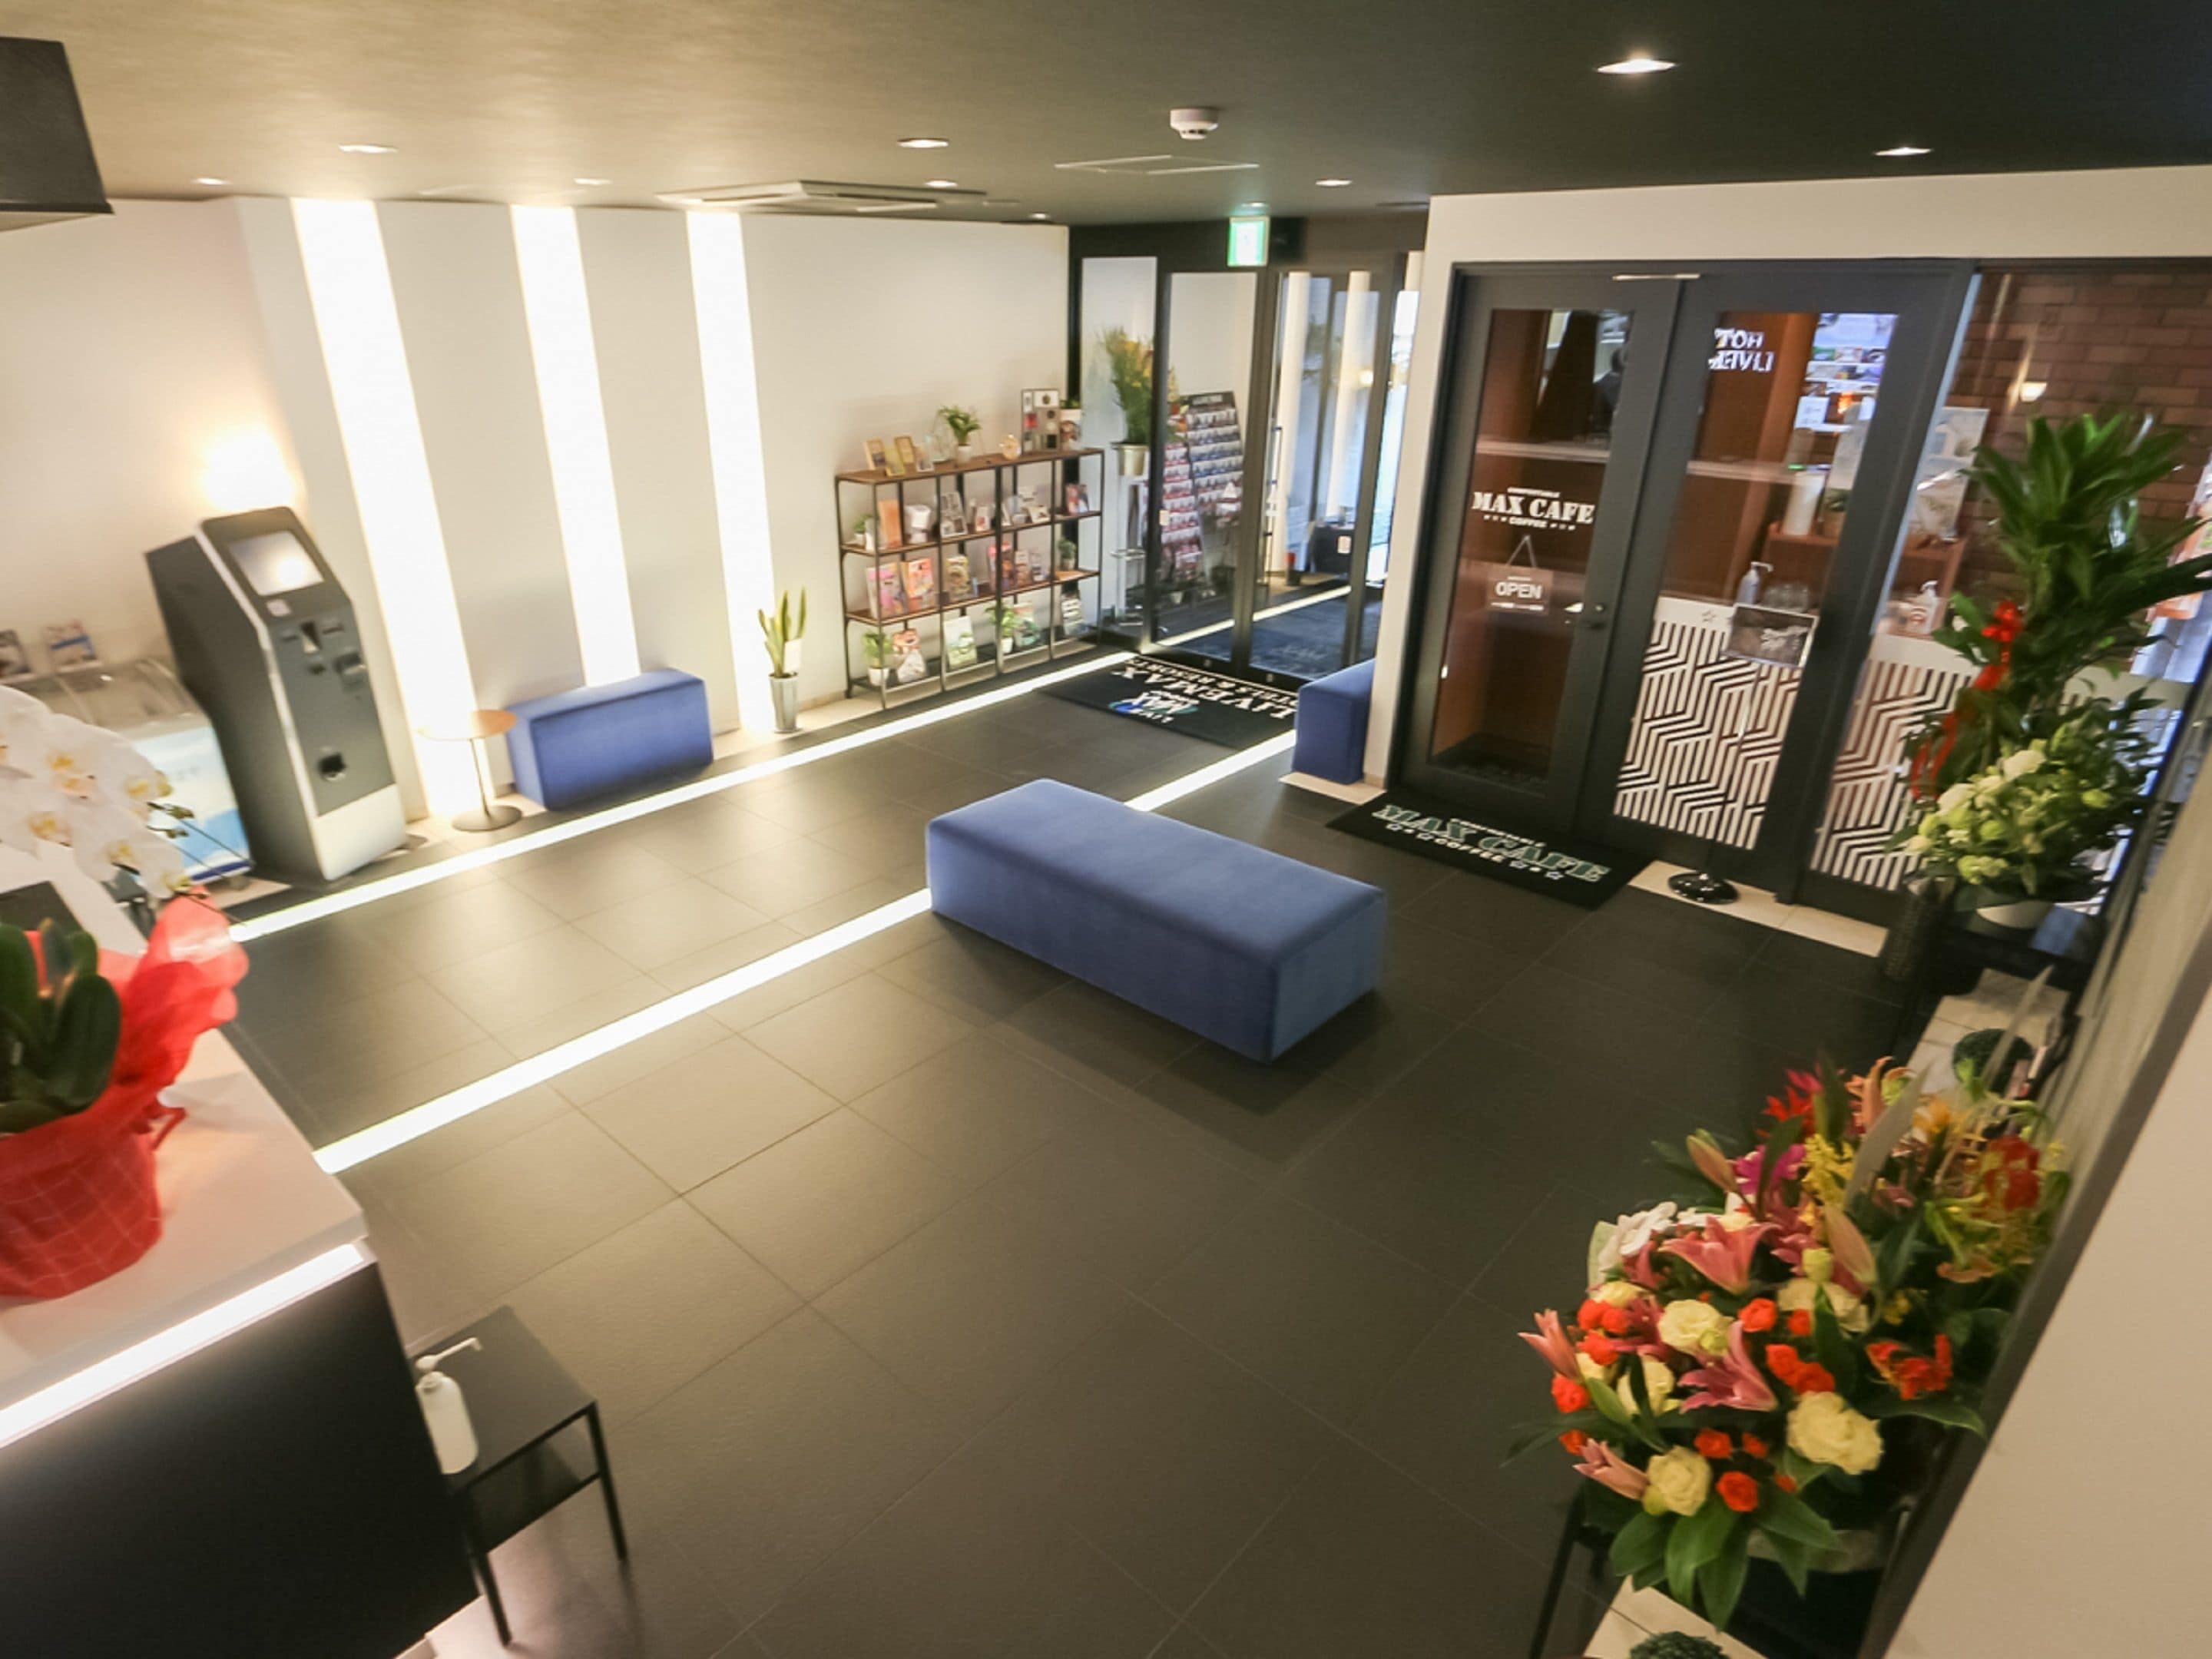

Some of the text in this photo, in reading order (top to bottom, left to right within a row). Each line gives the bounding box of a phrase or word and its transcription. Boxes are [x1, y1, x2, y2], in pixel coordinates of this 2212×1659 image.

[1472, 492, 1525, 515] MAX
[1529, 499, 1595, 524] CAFE
[1495, 581, 1542, 599] OPEN
[1111, 666, 1298, 719] LIVEMAX
[1371, 804, 1476, 843] MAX
[1479, 836, 1611, 882] CAFE
[1434, 837, 1505, 863] COFFEE
